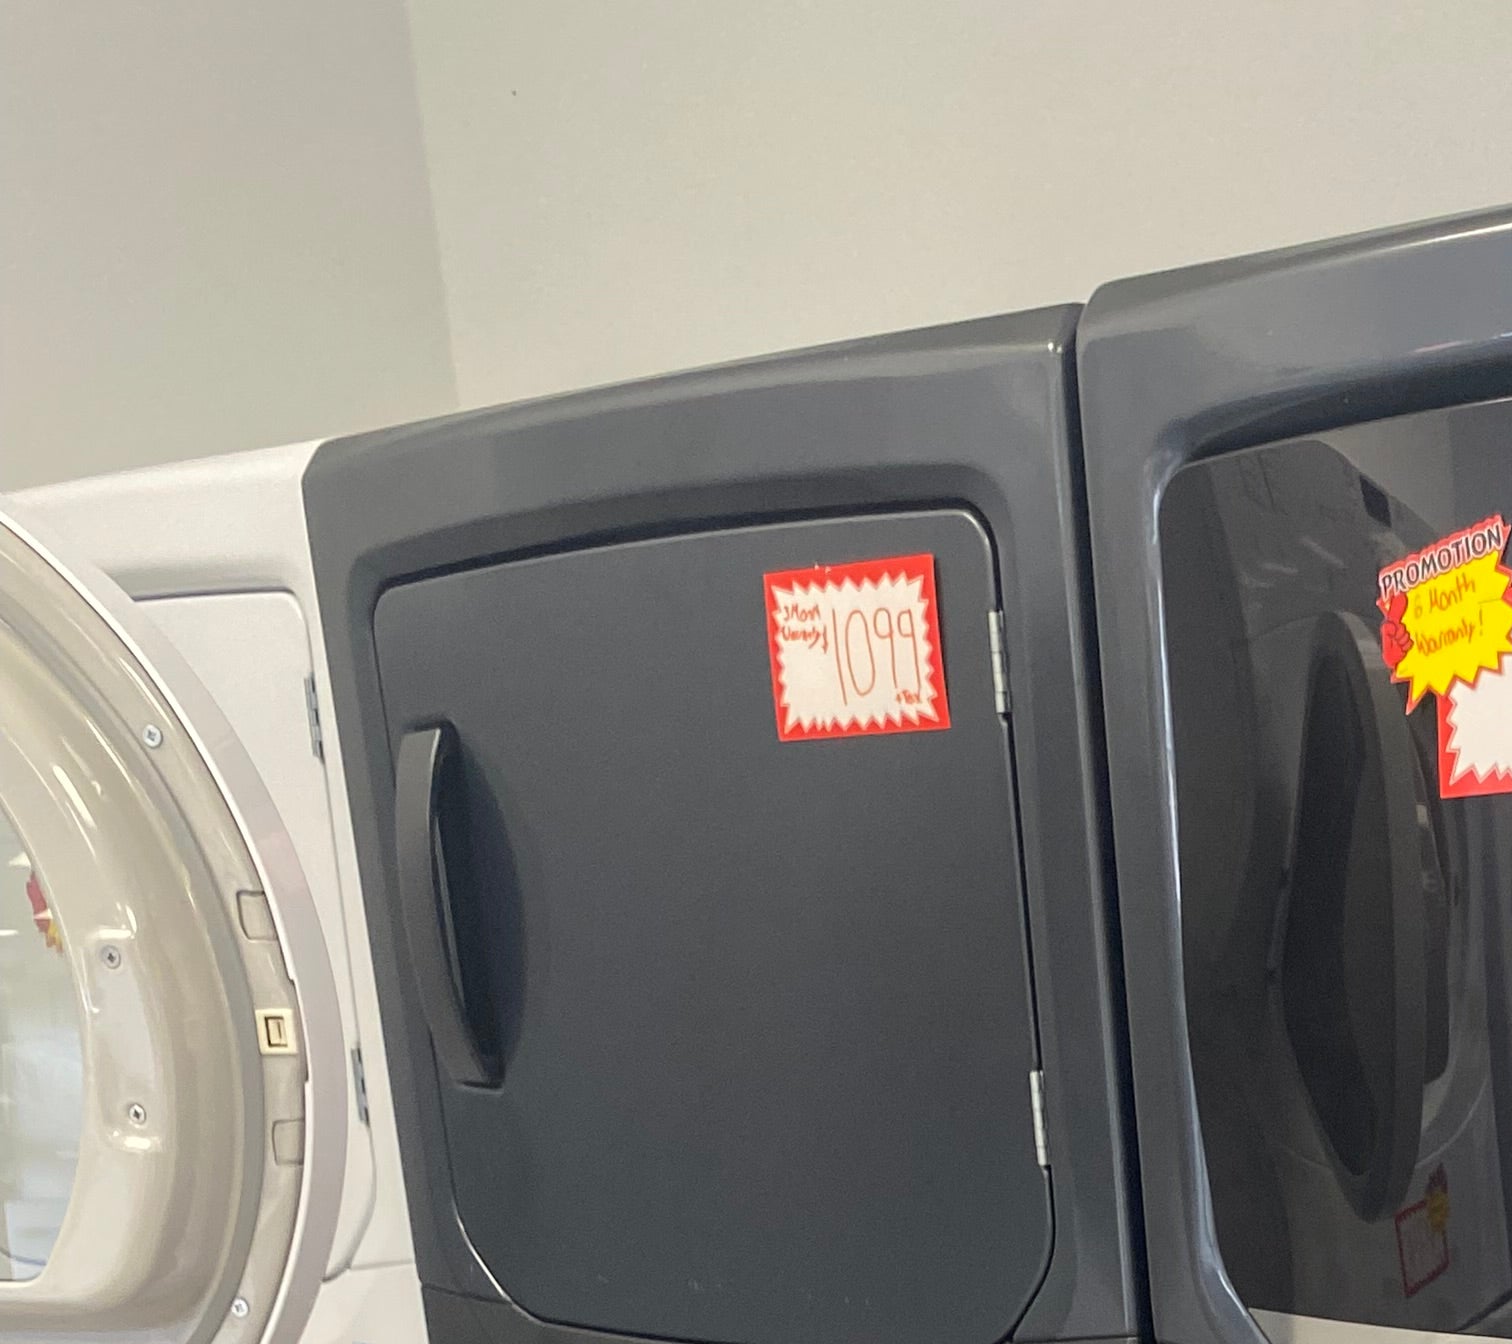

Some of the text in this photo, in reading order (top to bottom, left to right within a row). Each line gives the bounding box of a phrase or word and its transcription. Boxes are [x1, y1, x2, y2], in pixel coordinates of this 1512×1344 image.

[1381, 524, 1502, 595] PROMOTION
[1414, 572, 1476, 618] 6 Month
[832, 607, 923, 707] 1099
